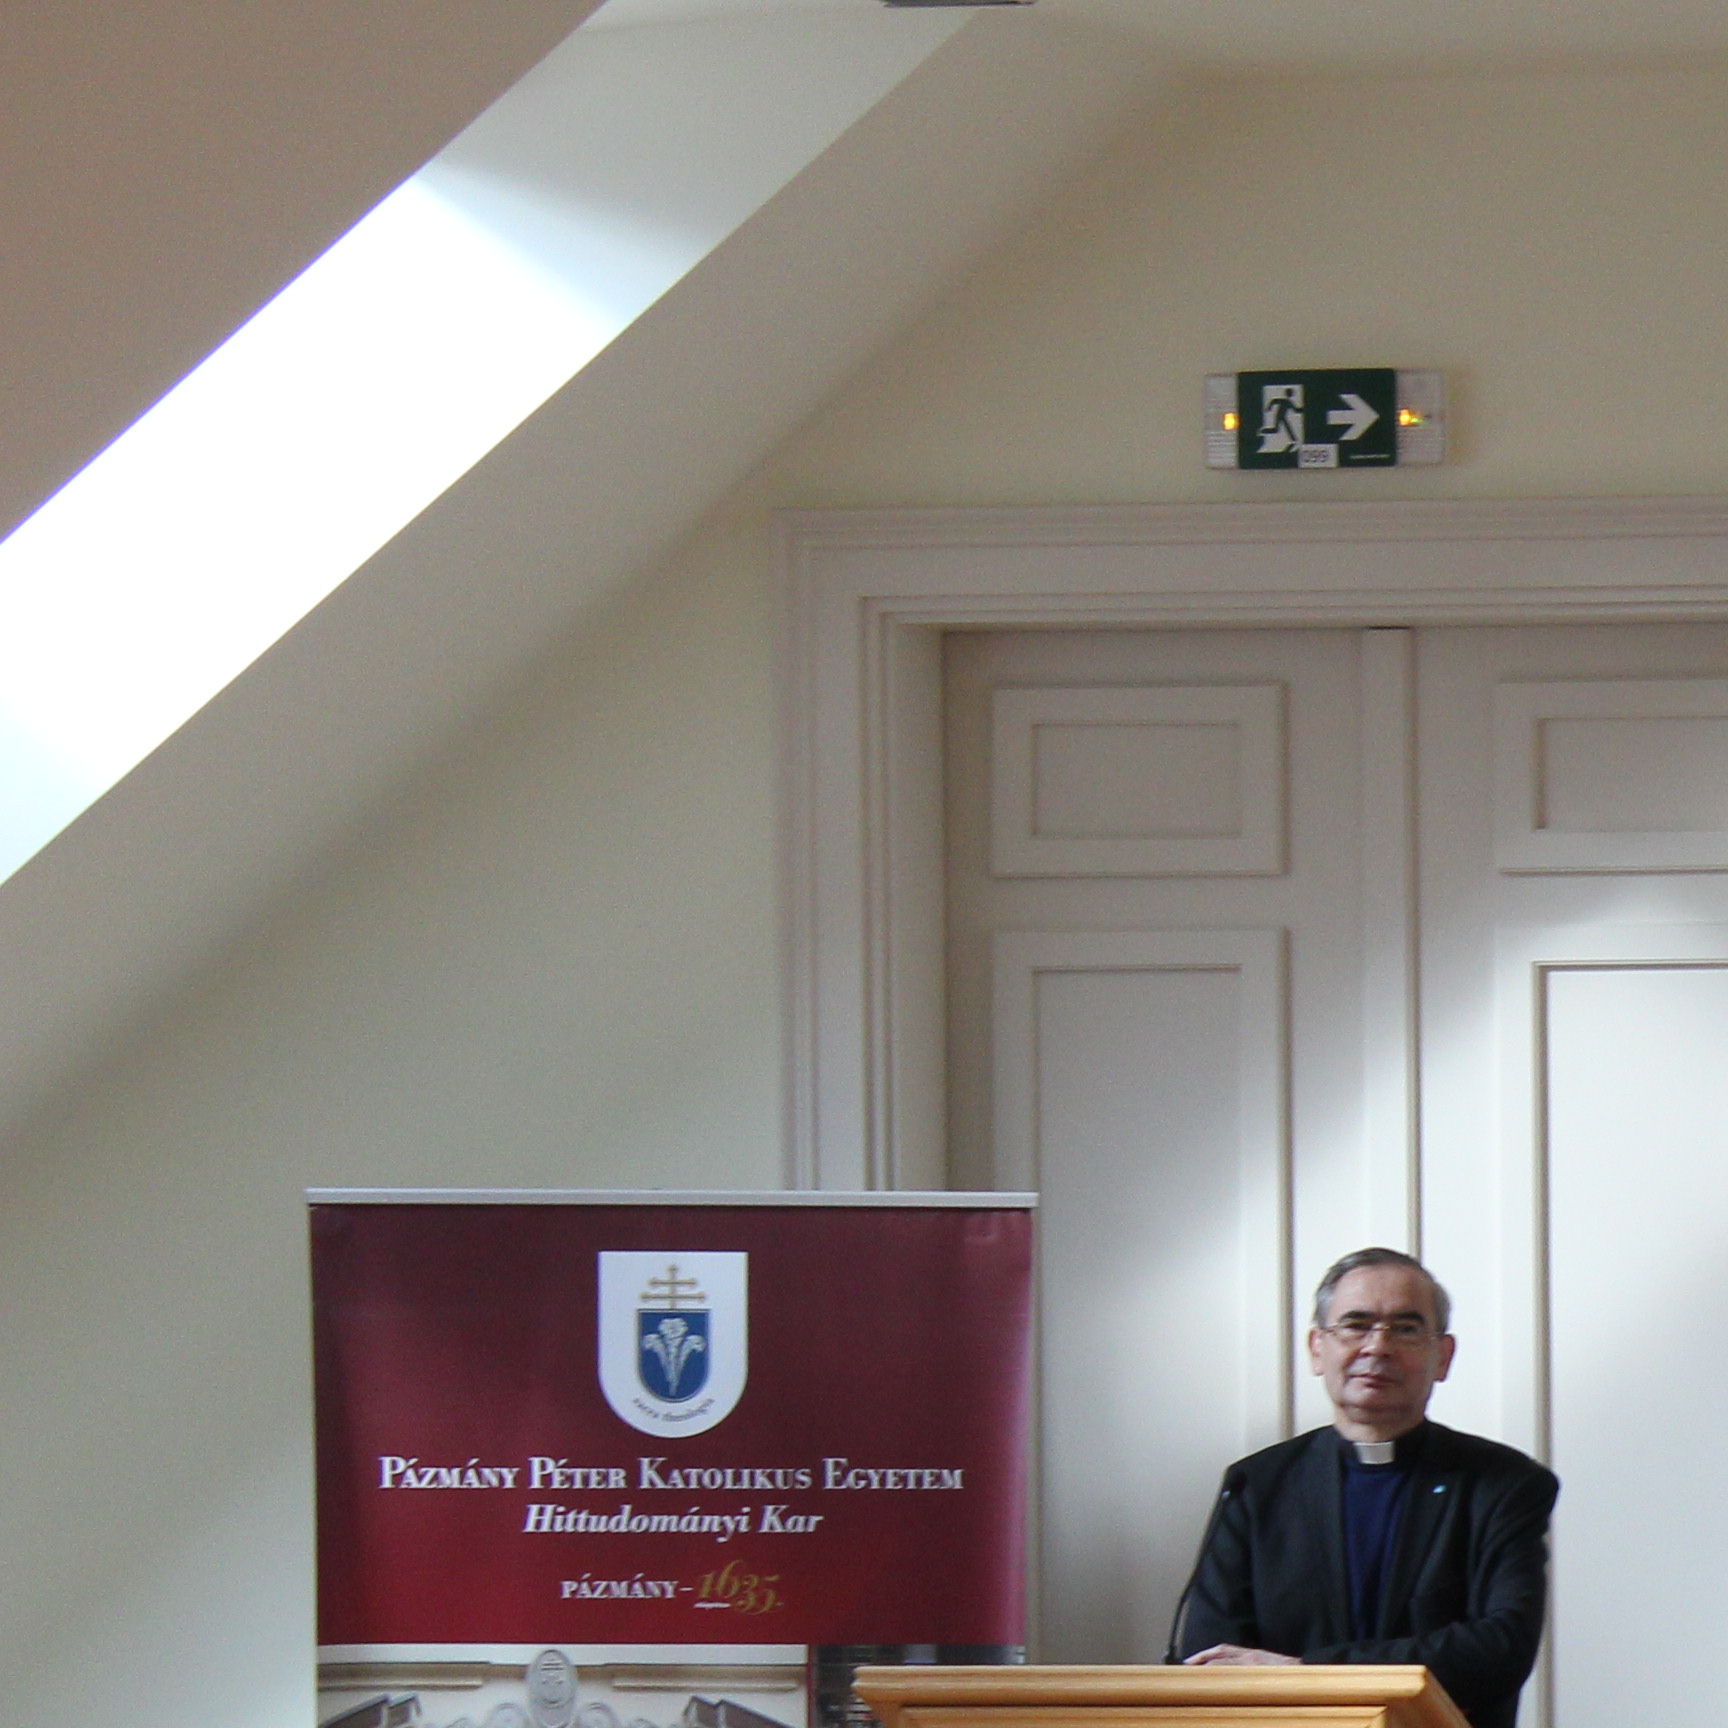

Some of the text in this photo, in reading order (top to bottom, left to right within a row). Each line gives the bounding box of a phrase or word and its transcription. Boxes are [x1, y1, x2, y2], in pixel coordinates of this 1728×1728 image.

[378, 1455, 964, 1490] PÁZMÁNY PÉTER KATOLIKUS EGYETEM
[522, 1503, 824, 1543] Hittudományi Kar
